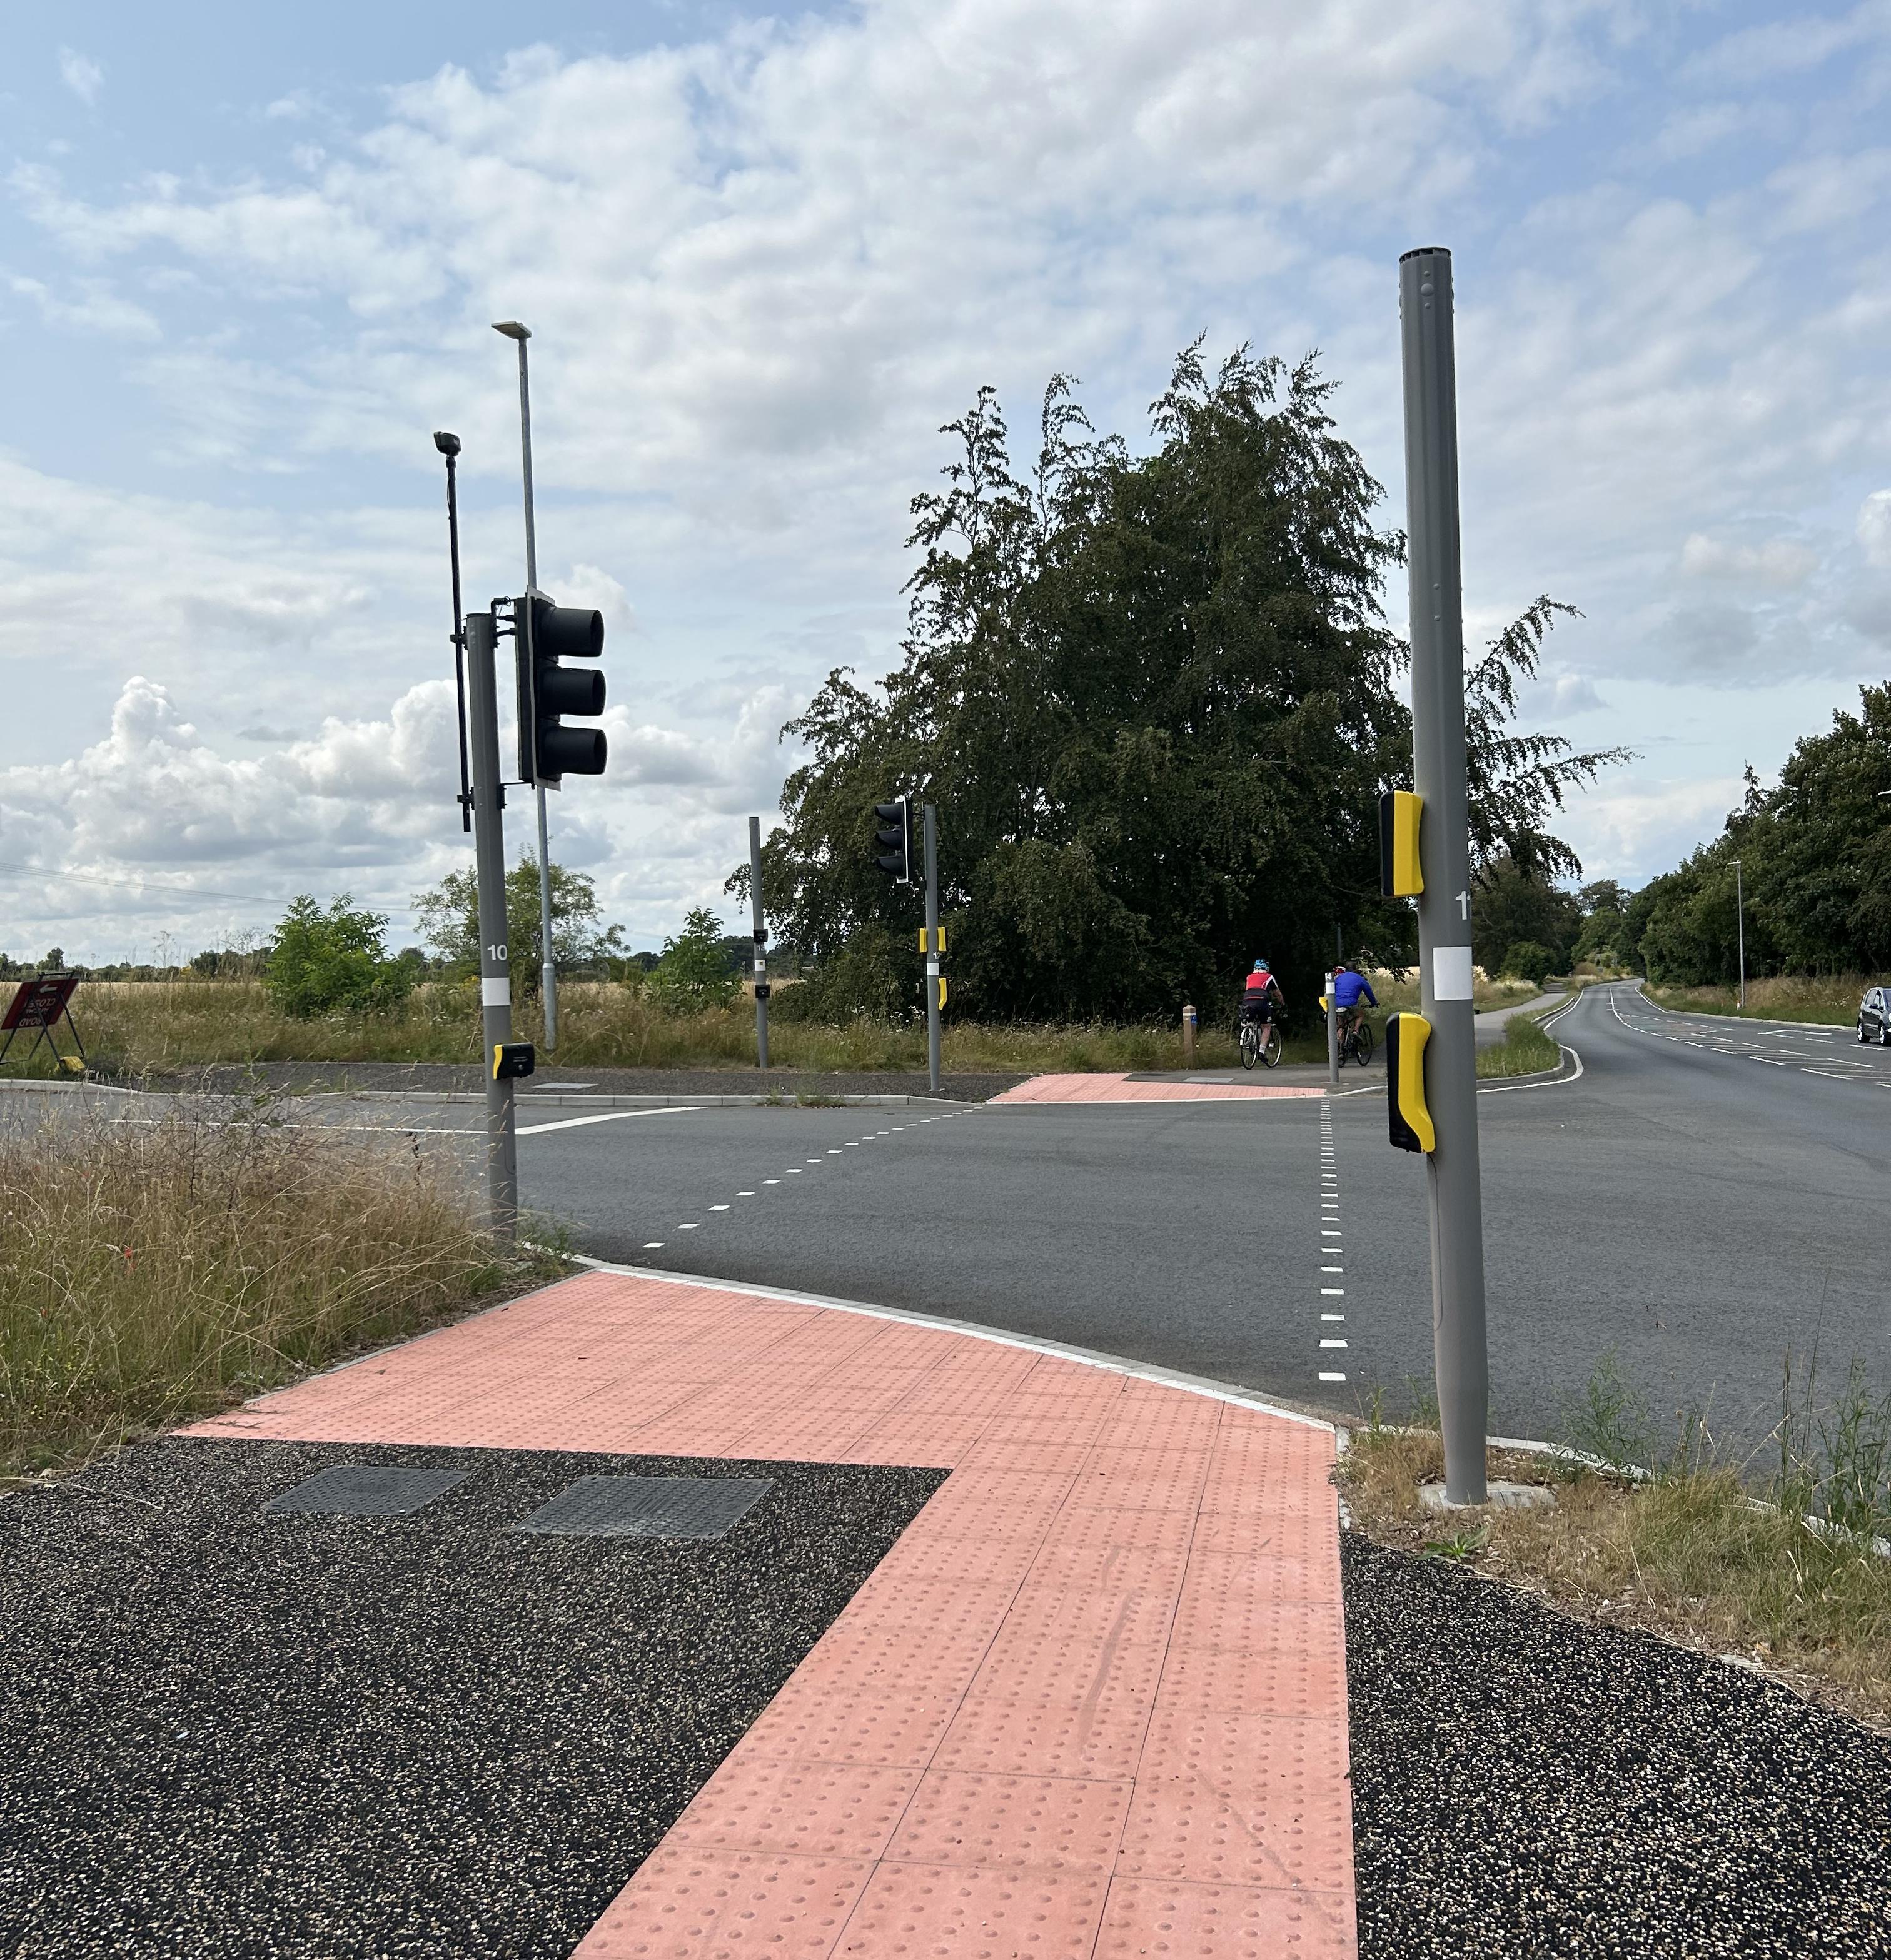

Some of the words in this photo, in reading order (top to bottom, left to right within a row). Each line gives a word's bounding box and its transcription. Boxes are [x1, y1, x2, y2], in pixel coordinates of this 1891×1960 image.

[1455, 890, 1471, 920] 1
[488, 944, 508, 961] 10
[19, 1017, 42, 1027] ROAD
